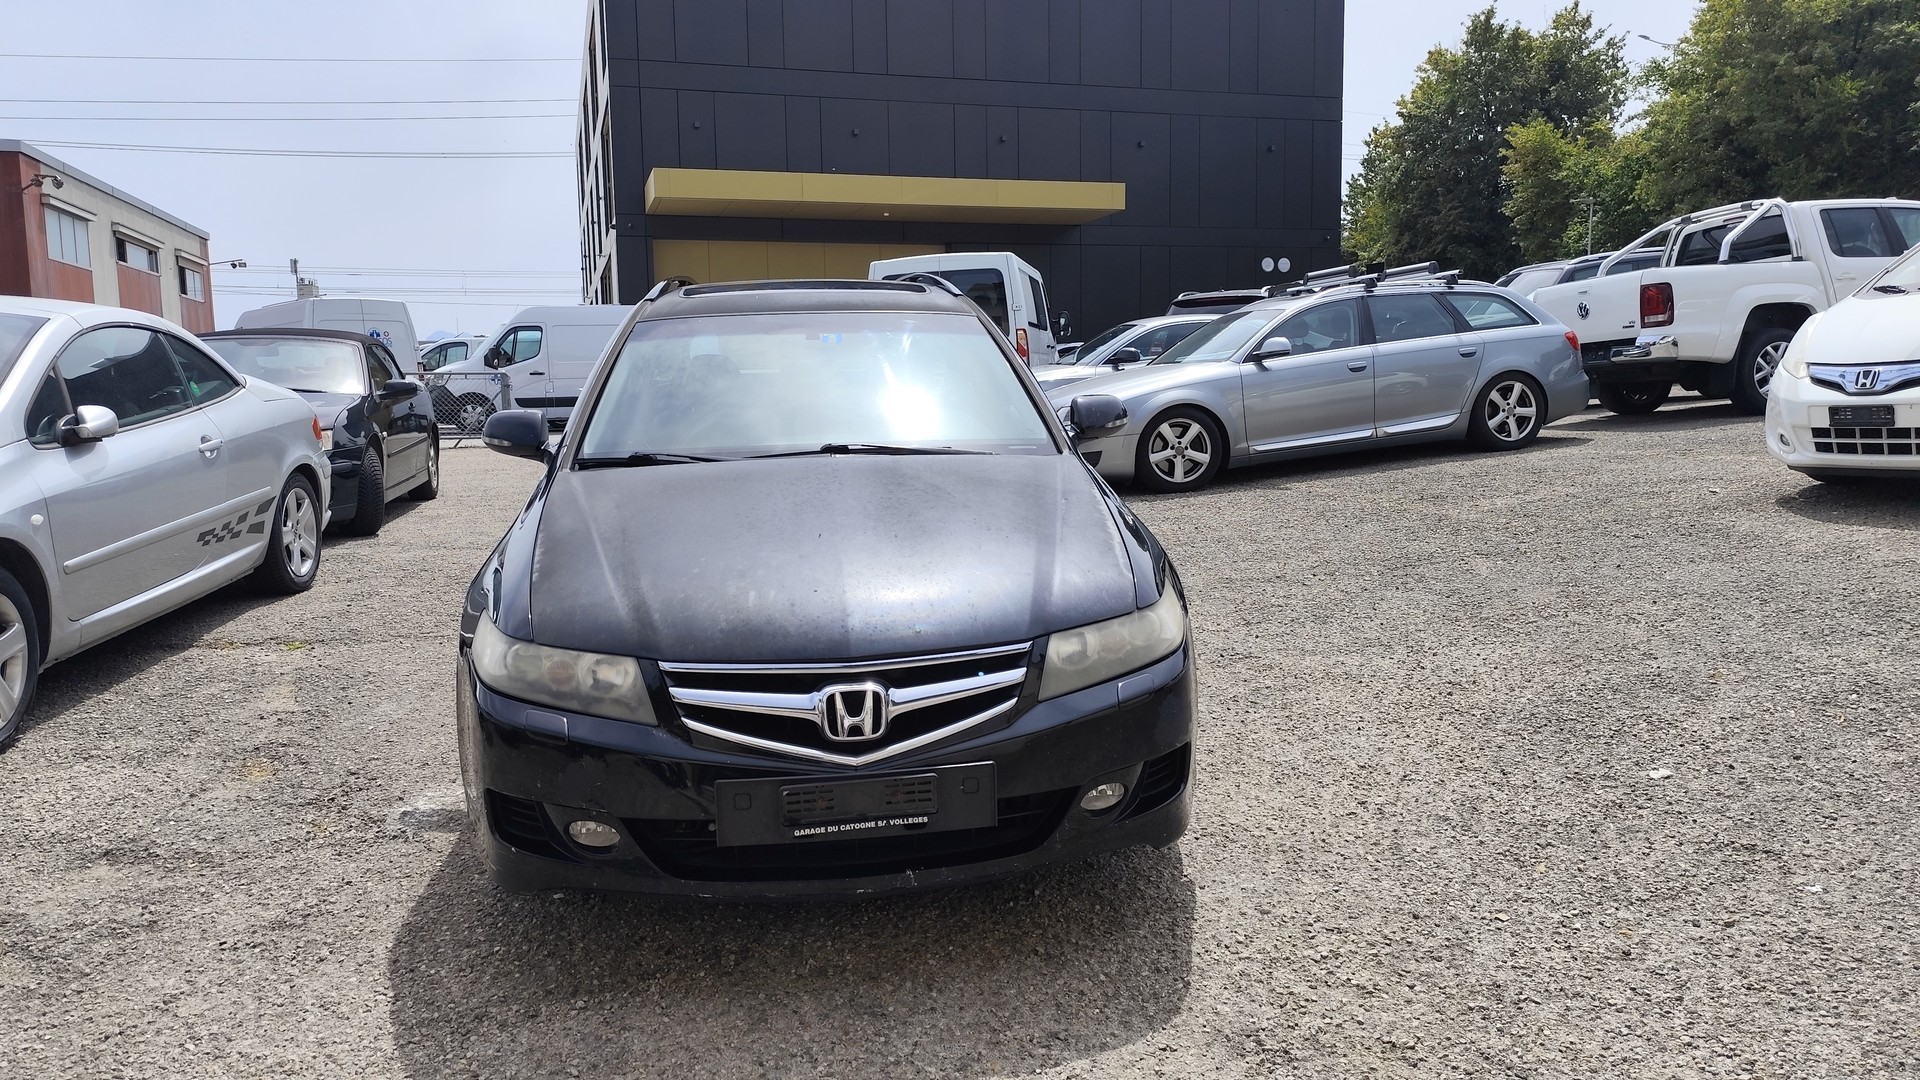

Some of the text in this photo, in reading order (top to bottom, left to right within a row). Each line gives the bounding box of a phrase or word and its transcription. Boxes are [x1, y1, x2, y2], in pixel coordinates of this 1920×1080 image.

[794, 827, 826, 836] GARAGE
[827, 825, 839, 833] DU
[840, 821, 876, 831] CATOGNE
[889, 816, 928, 825] VOLLEGES
